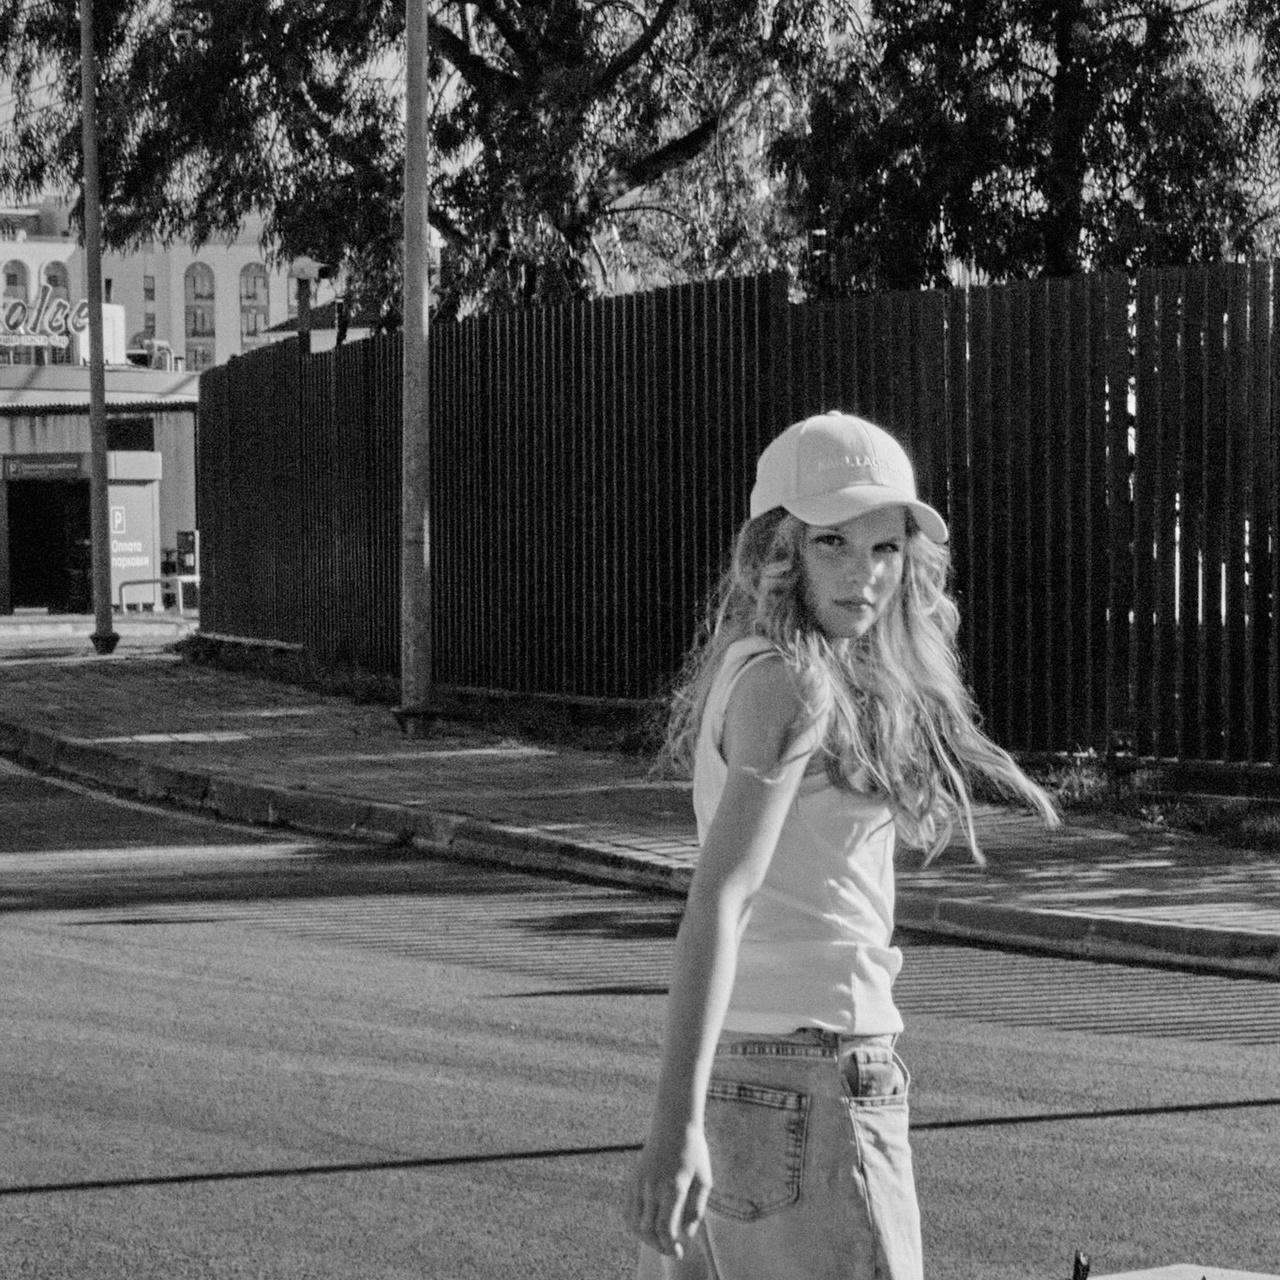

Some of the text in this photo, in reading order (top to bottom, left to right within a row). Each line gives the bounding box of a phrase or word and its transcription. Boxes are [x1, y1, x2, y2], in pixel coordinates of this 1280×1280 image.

[0, 283, 88, 334] olce
[111, 539, 142, 553] Оплата
[111, 556, 149, 570] парковки
